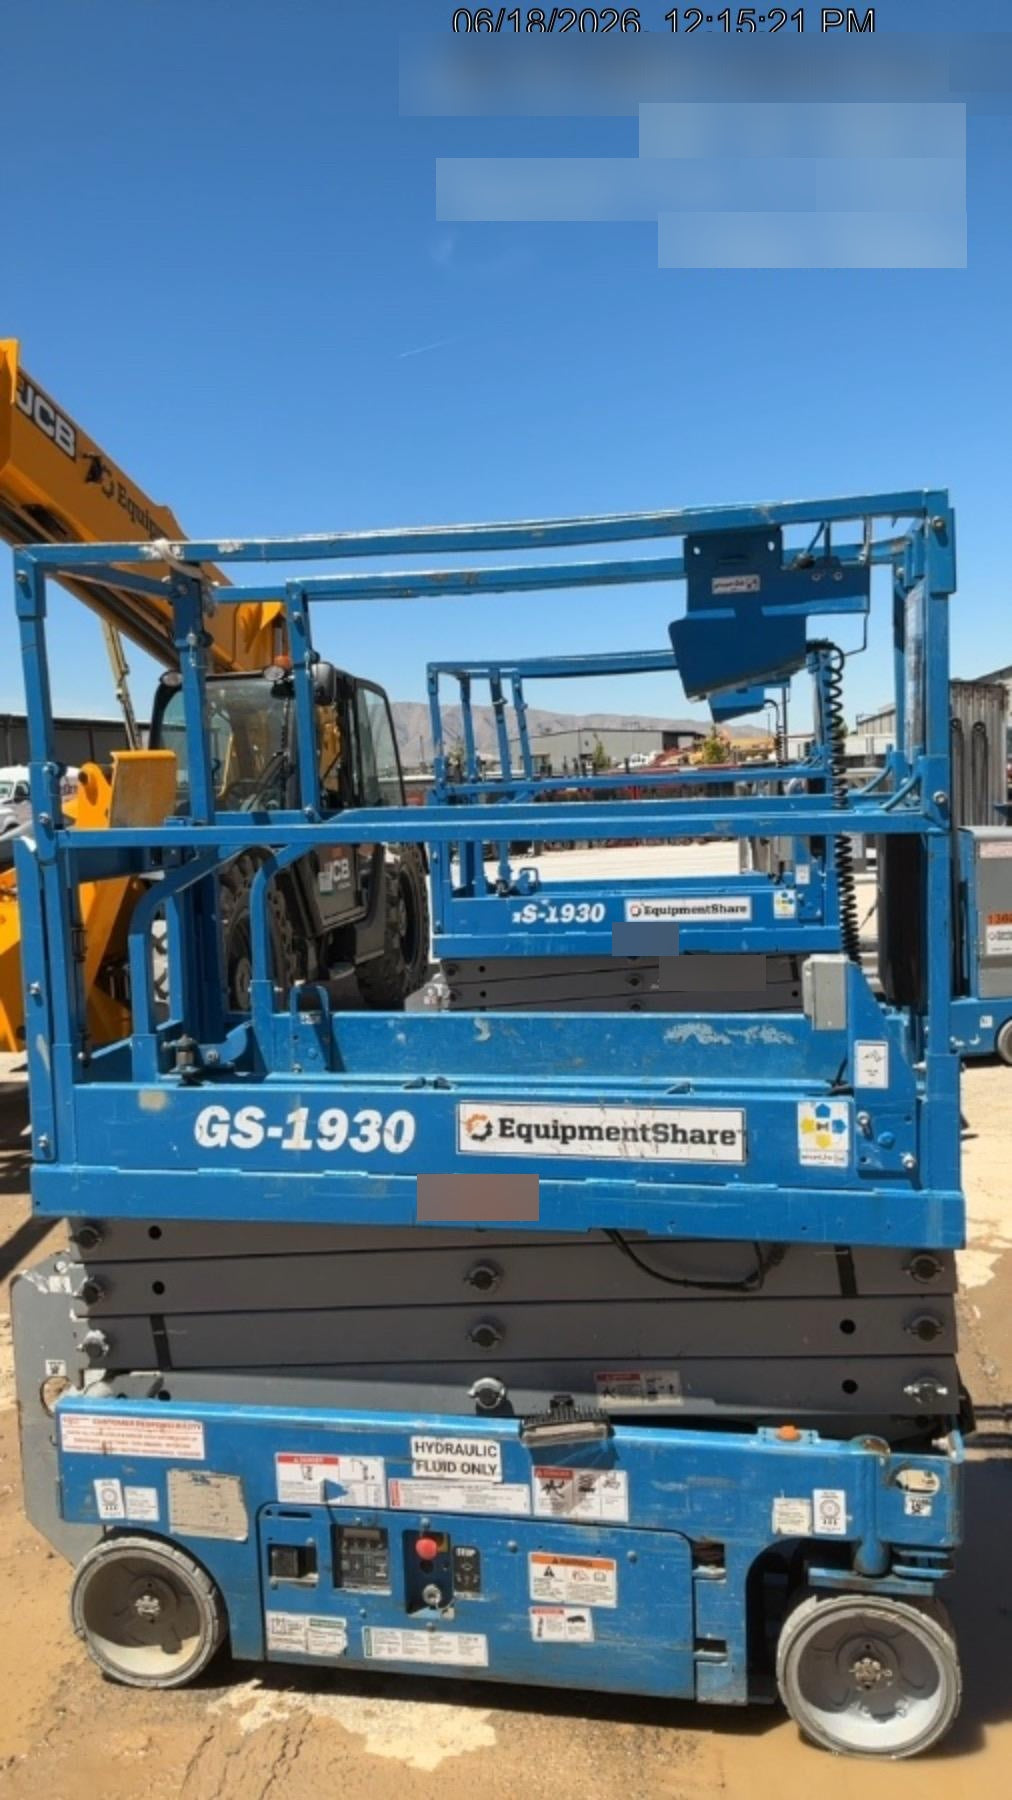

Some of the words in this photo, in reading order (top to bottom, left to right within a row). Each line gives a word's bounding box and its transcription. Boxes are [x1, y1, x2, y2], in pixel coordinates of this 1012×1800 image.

[643, 903, 747, 917] EquipmentShare
[194, 1105, 416, 1154] GS-1930
[498, 1117, 737, 1146] EquipmentShare
[415, 1441, 497, 1457] HYDRAULIC
[415, 1460, 457, 1473] FLUID
[460, 1461, 498, 1476] ONLY
